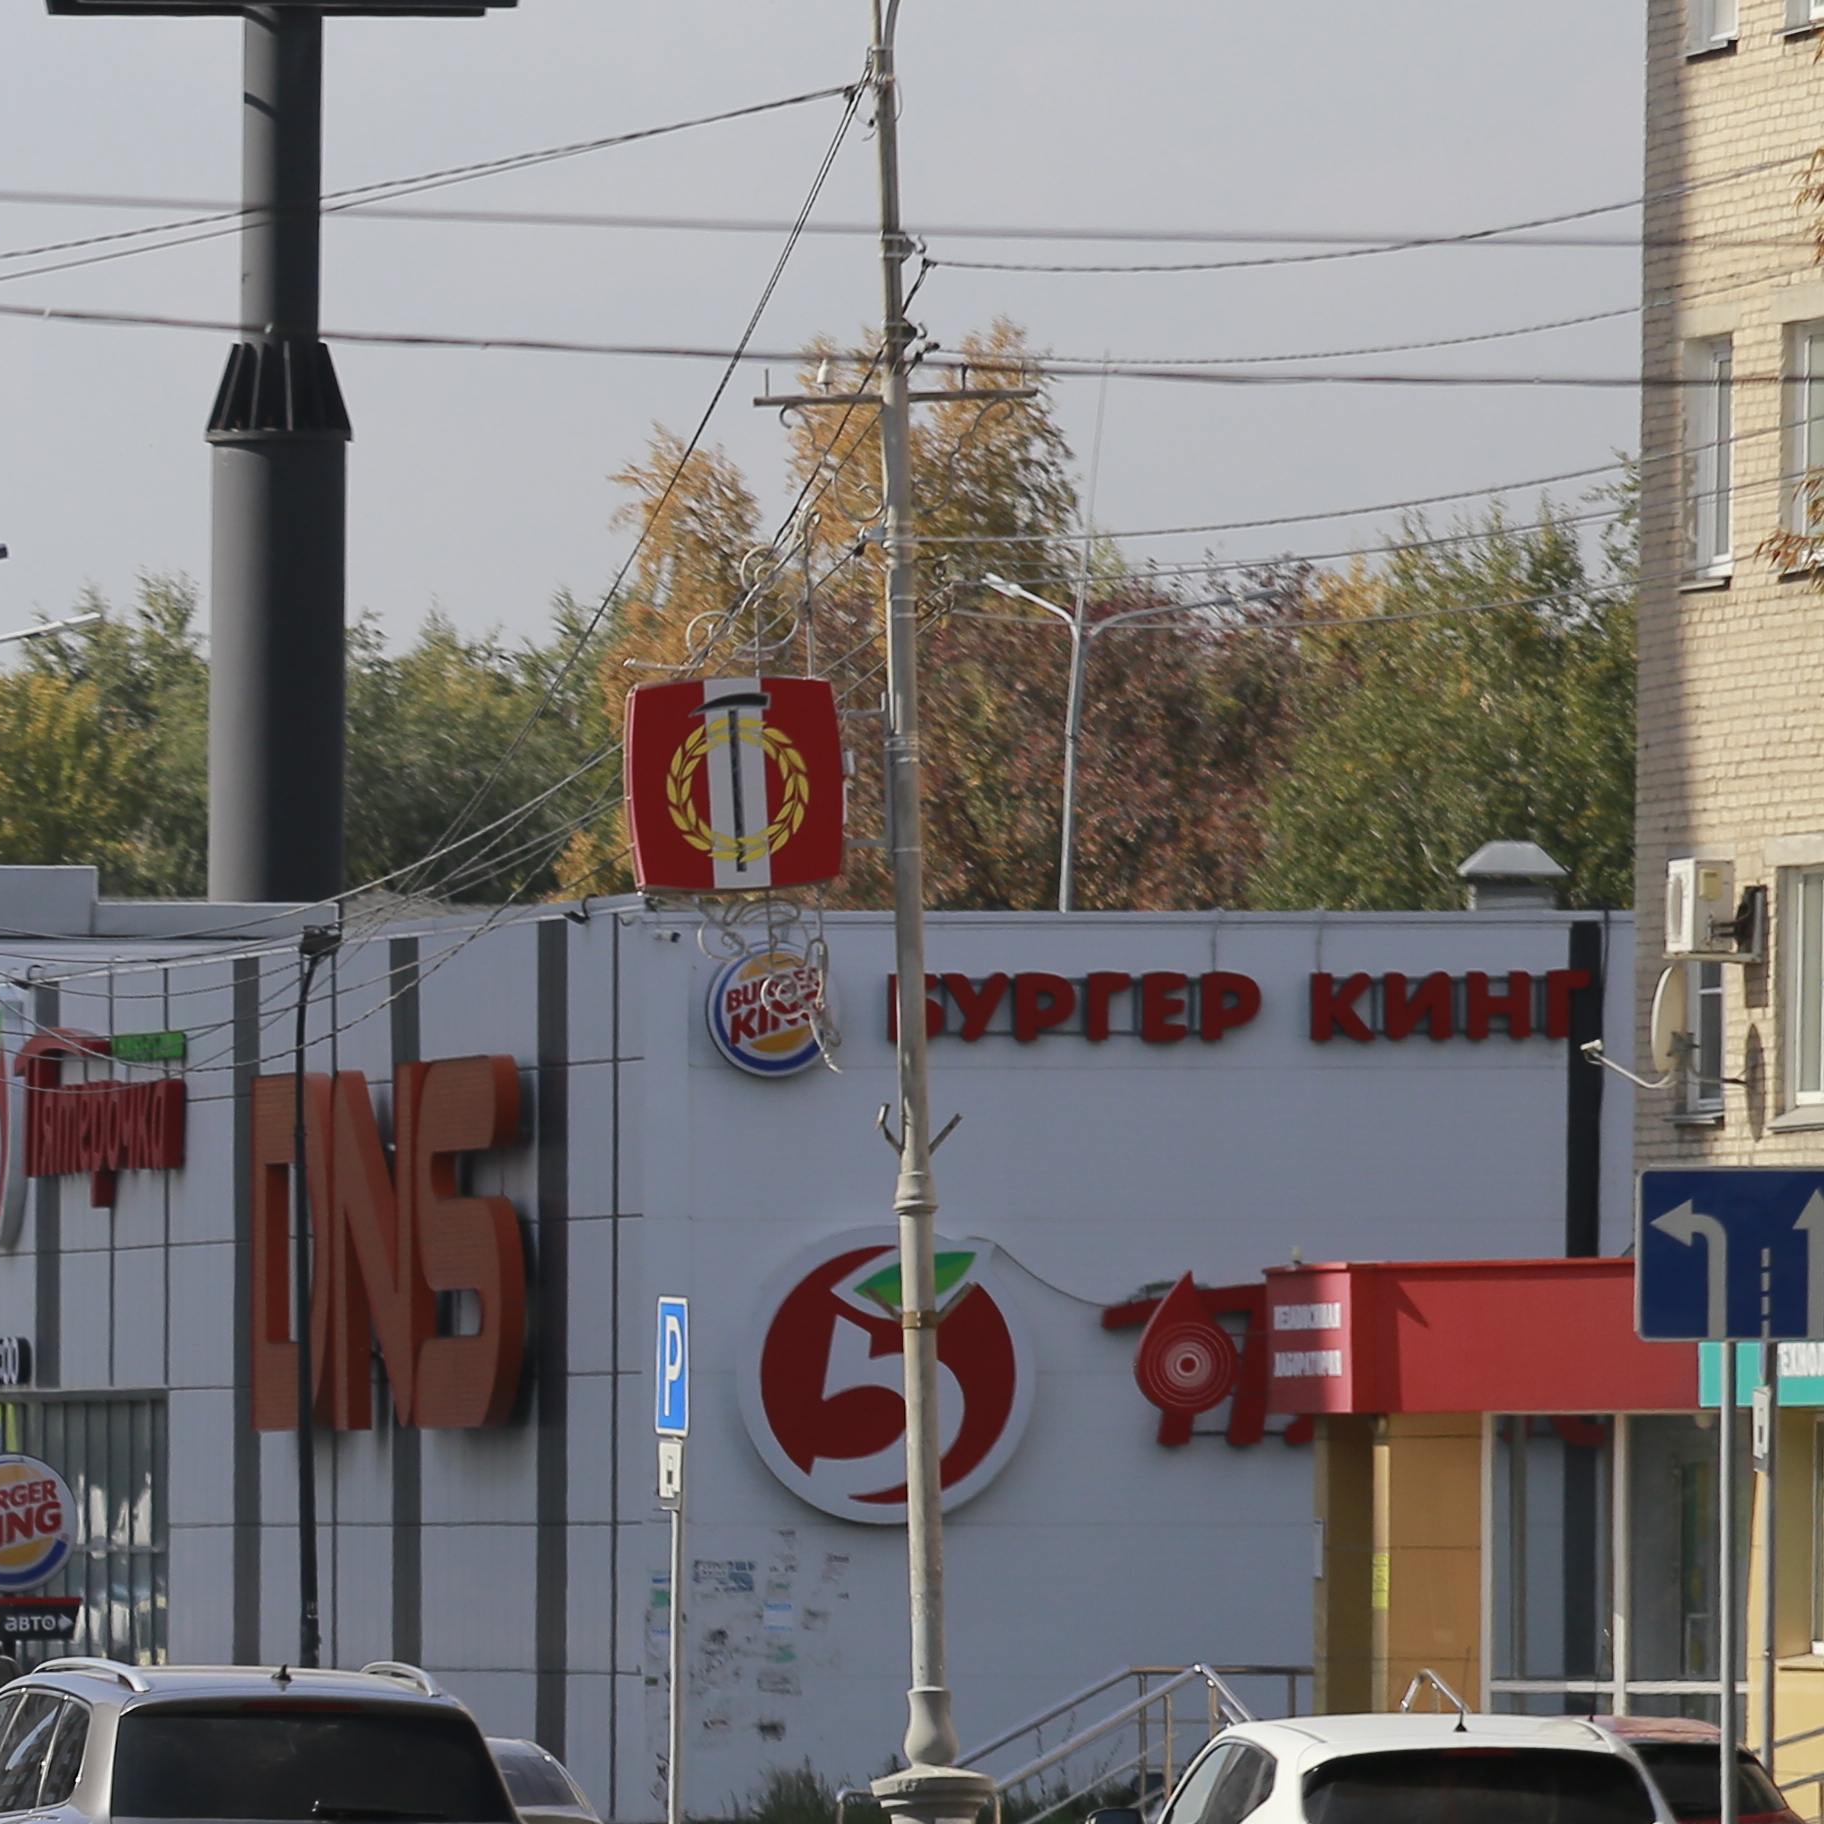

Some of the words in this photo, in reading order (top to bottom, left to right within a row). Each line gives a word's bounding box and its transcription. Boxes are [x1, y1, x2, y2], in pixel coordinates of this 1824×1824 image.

[887, 970, 1263, 1042] БУРГЕР
[1309, 968, 1591, 1042] КИНГ
[252, 1054, 527, 1431] DNS
[664, 1314, 683, 1417] P
